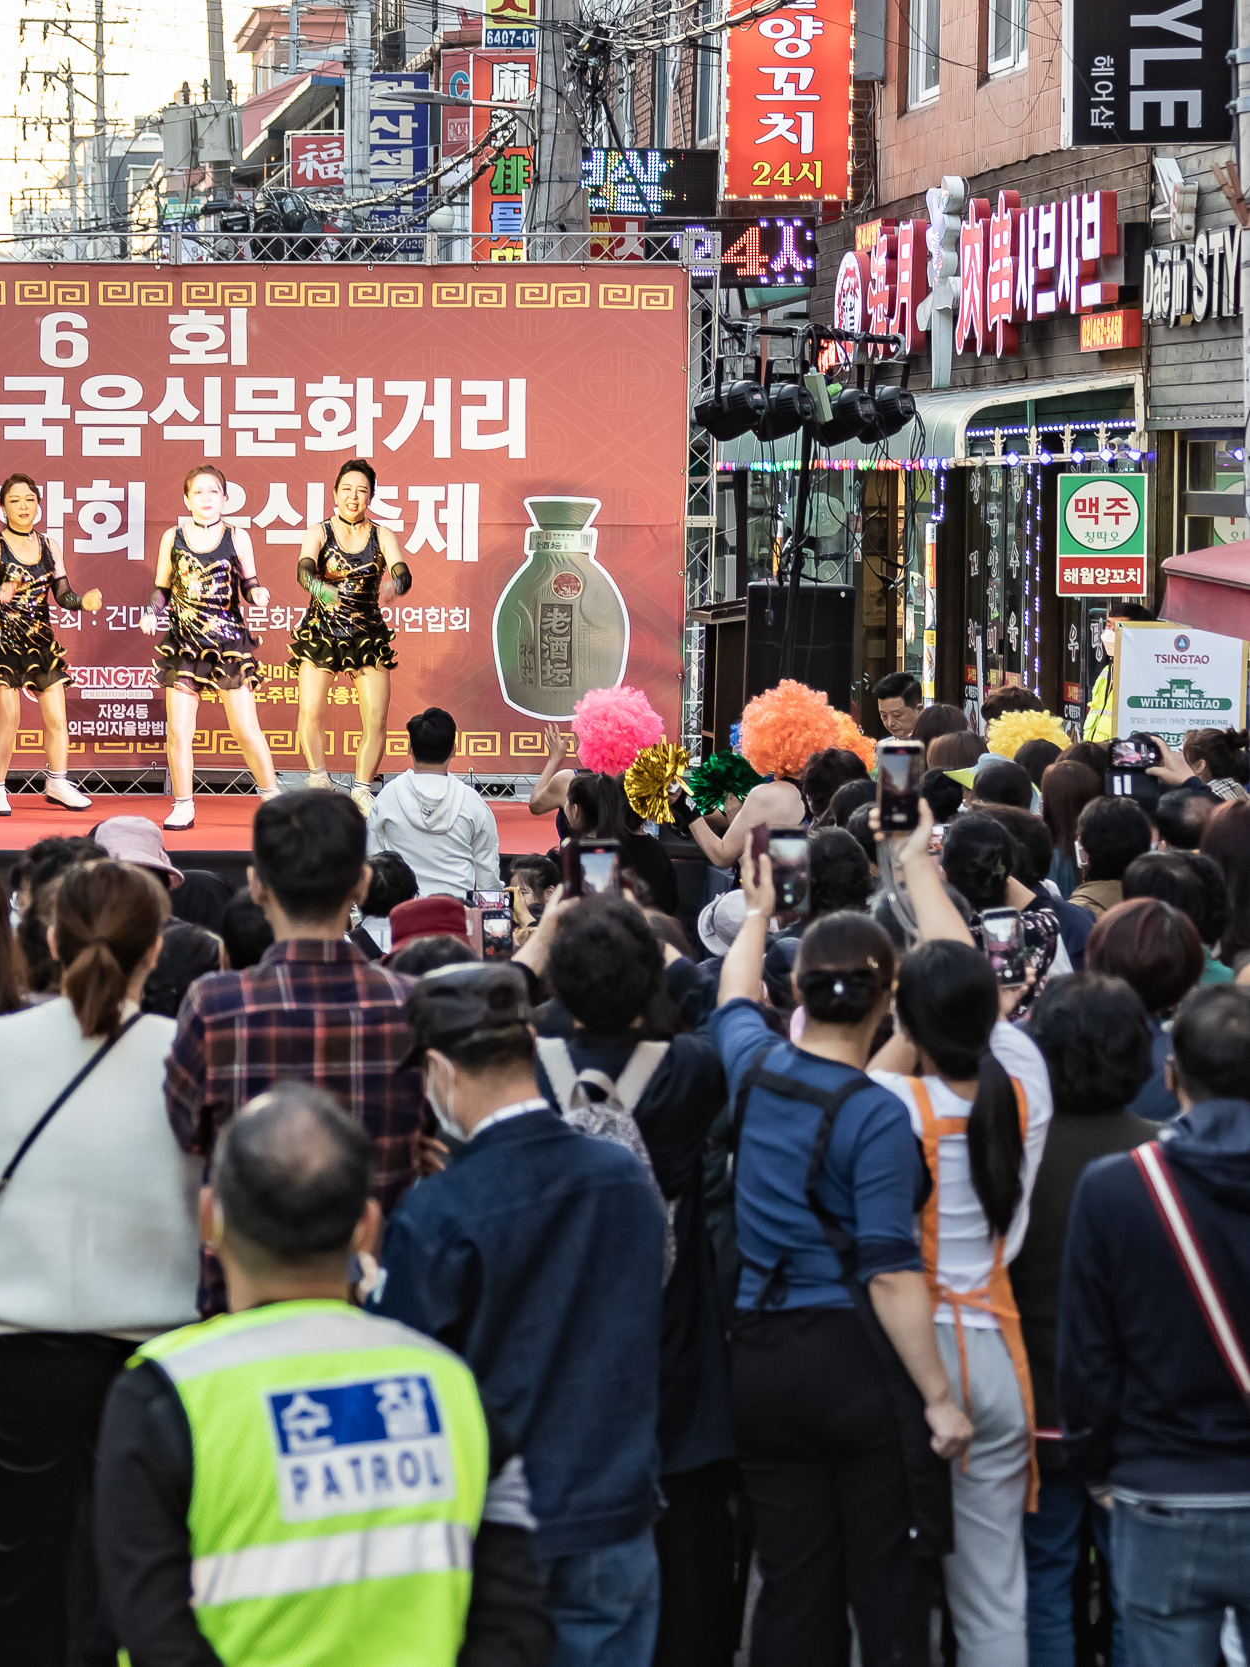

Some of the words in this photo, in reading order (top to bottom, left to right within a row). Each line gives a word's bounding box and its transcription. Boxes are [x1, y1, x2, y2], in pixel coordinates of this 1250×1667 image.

[487, 30, 535, 45] 6407-01
[755, 0, 824, 155] 양꼬치
[297, 141, 344, 180] 福
[752, 160, 822, 189] 24시
[1015, 190, 1101, 321] 샤브샤브
[1193, 228, 1243, 322] STY
[39, 312, 90, 369] 6
[168, 308, 248, 367] 회
[1075, 497, 1131, 526] 맥주
[1084, 531, 1120, 543] 칭따오
[1063, 567, 1141, 585] 해월양꼬치
[384, 606, 471, 632] 인연합회
[1154, 654, 1210, 665] TSINGTAO
[67, 667, 159, 689] TSINGTA
[98, 703, 149, 720] 자양4동
[1140, 697, 1168, 708] WITH
[1171, 698, 1220, 710] TSINGTAO
[291, 1450, 442, 1504] PATROL
